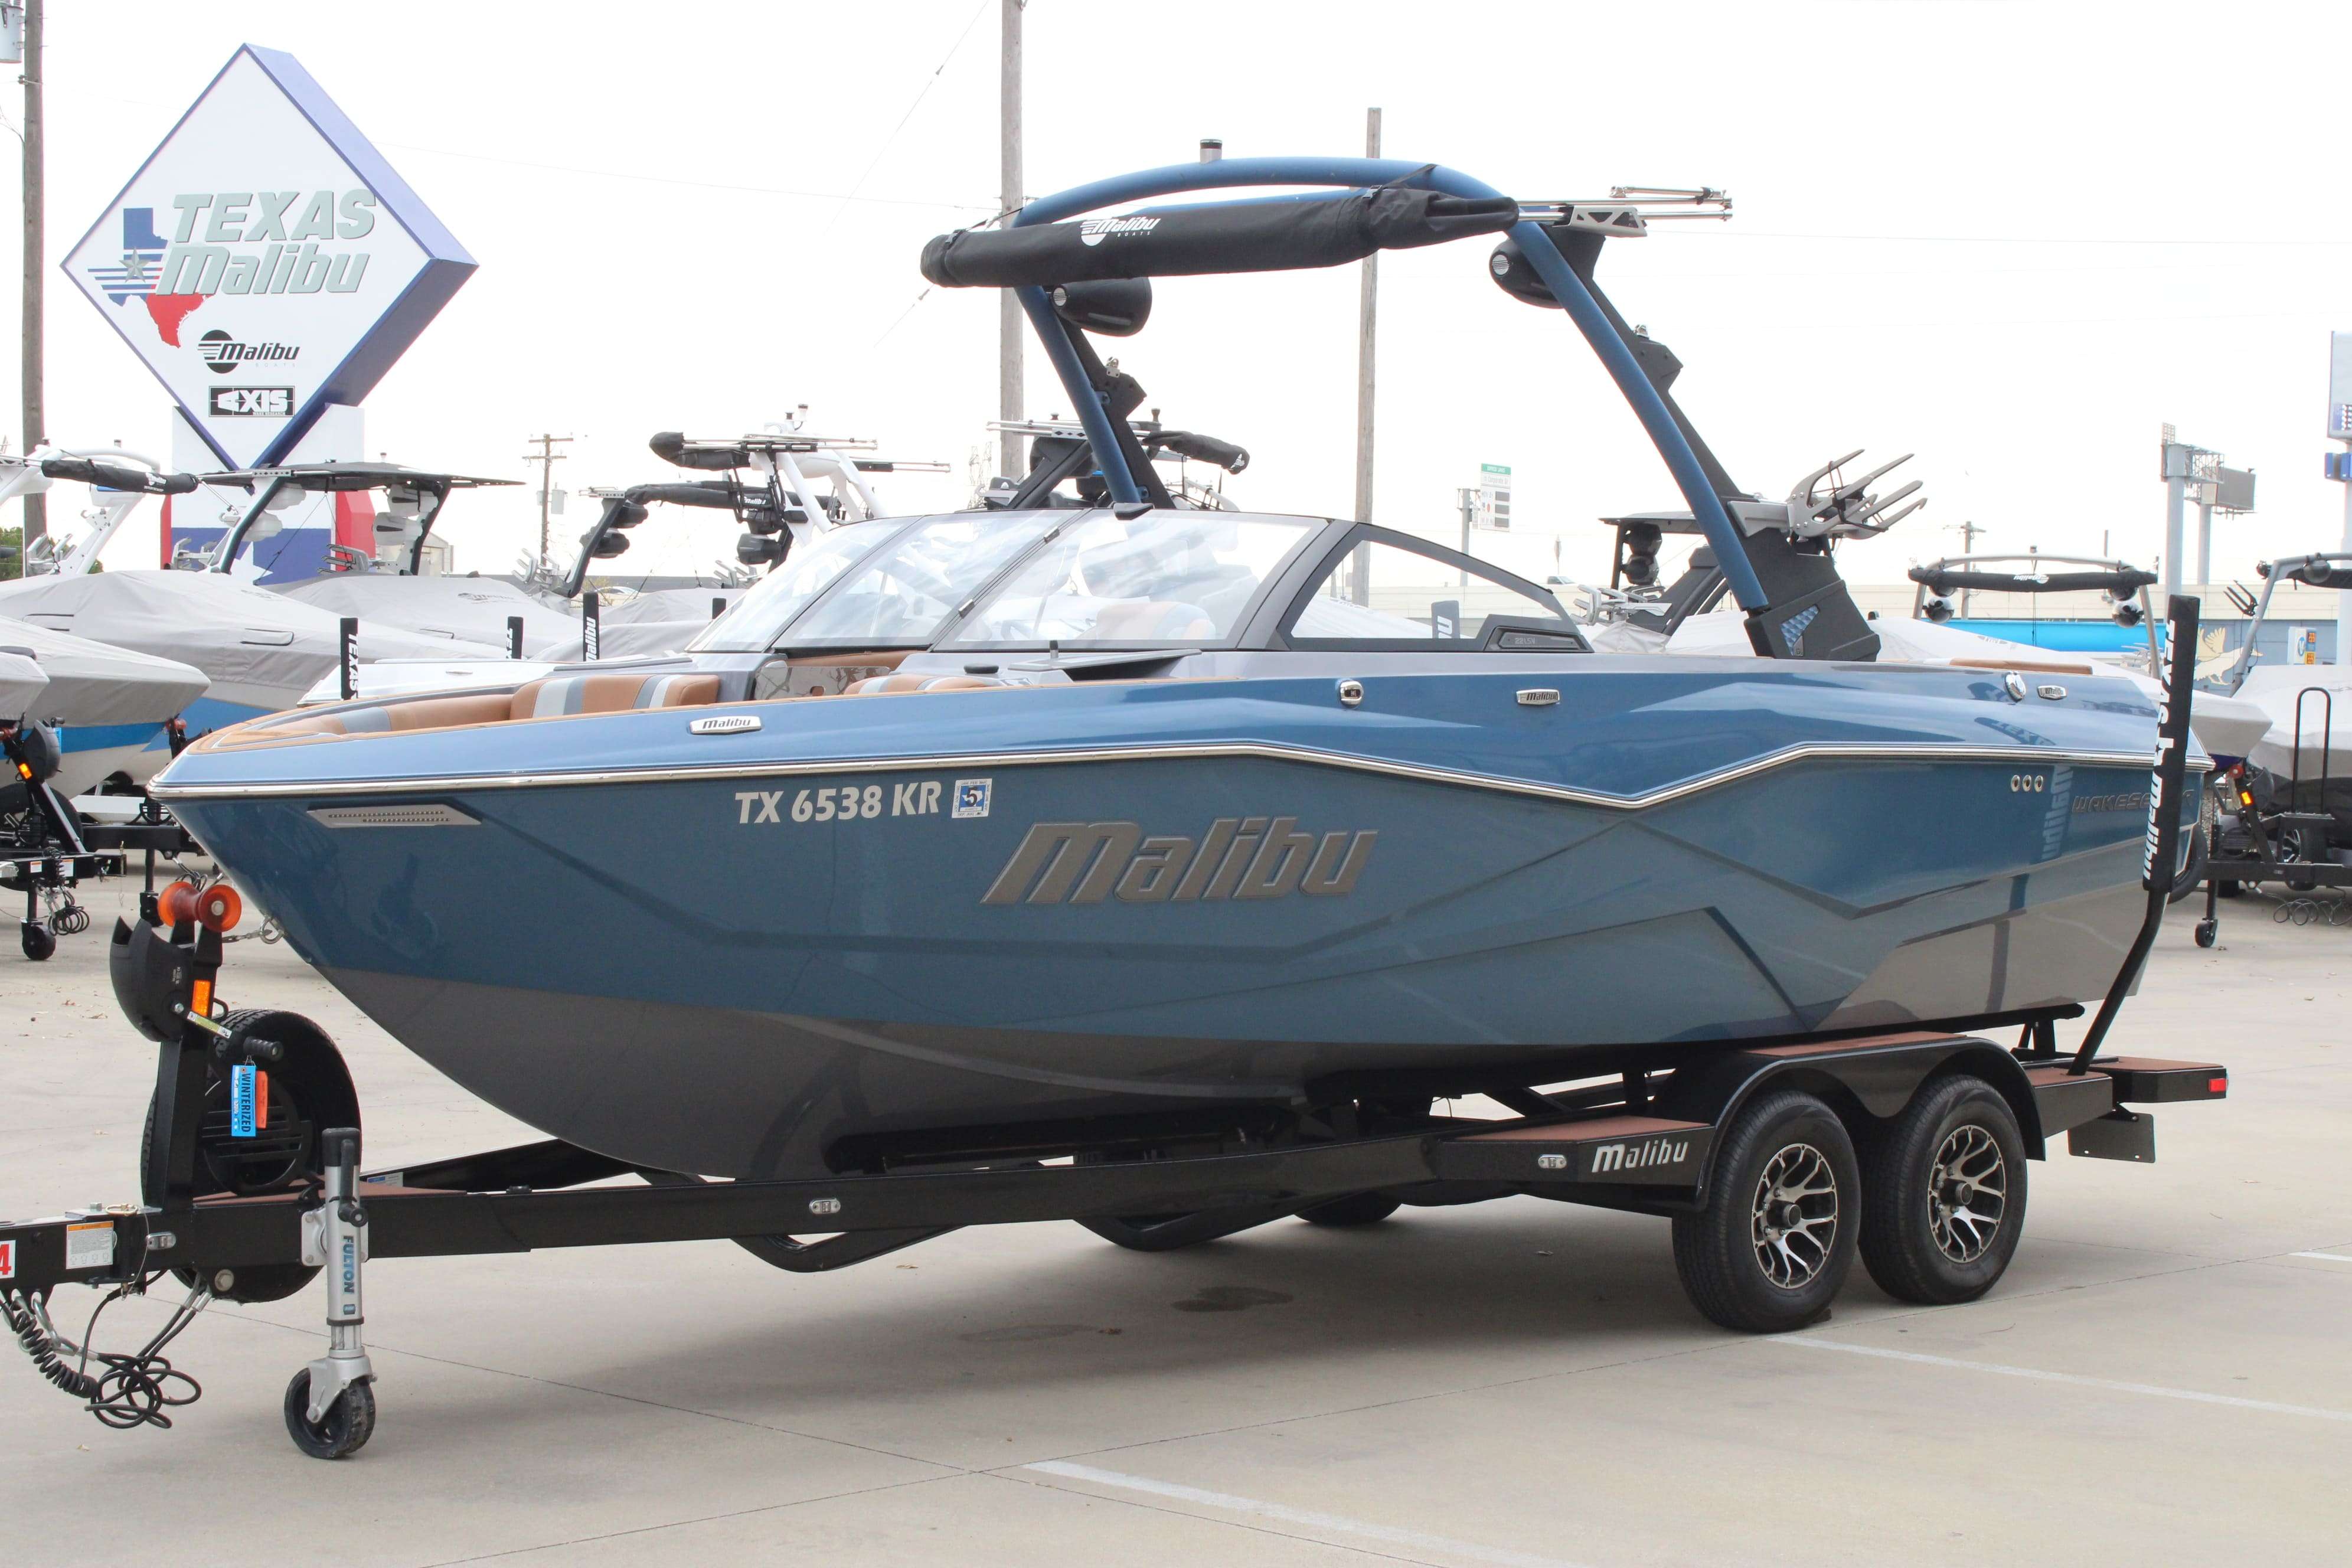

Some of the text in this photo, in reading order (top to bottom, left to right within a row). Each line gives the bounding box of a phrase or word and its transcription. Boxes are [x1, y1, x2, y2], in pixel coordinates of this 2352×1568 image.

[173, 189, 377, 243] TEXAS
[1090, 216, 1161, 234] Malibu
[155, 243, 370, 295] Malibu
[217, 342, 300, 360] Malibu
[217, 390, 288, 412] AXIS
[348, 633, 358, 691] TEXAS
[1526, 692, 1556, 701] Malibu
[702, 716, 752, 729] Malibu
[734, 790, 784, 824] TX
[791, 785, 883, 822] 6538
[891, 780, 942, 817] KR
[965, 786, 978, 807] 5
[2142, 770, 2163, 880] Malibu
[980, 816, 1379, 904] Malibu
[241, 1073, 251, 1132] WINTERIZED
[1591, 1138, 1690, 1173] Malibu
[343, 1235, 355, 1293] FULTON
